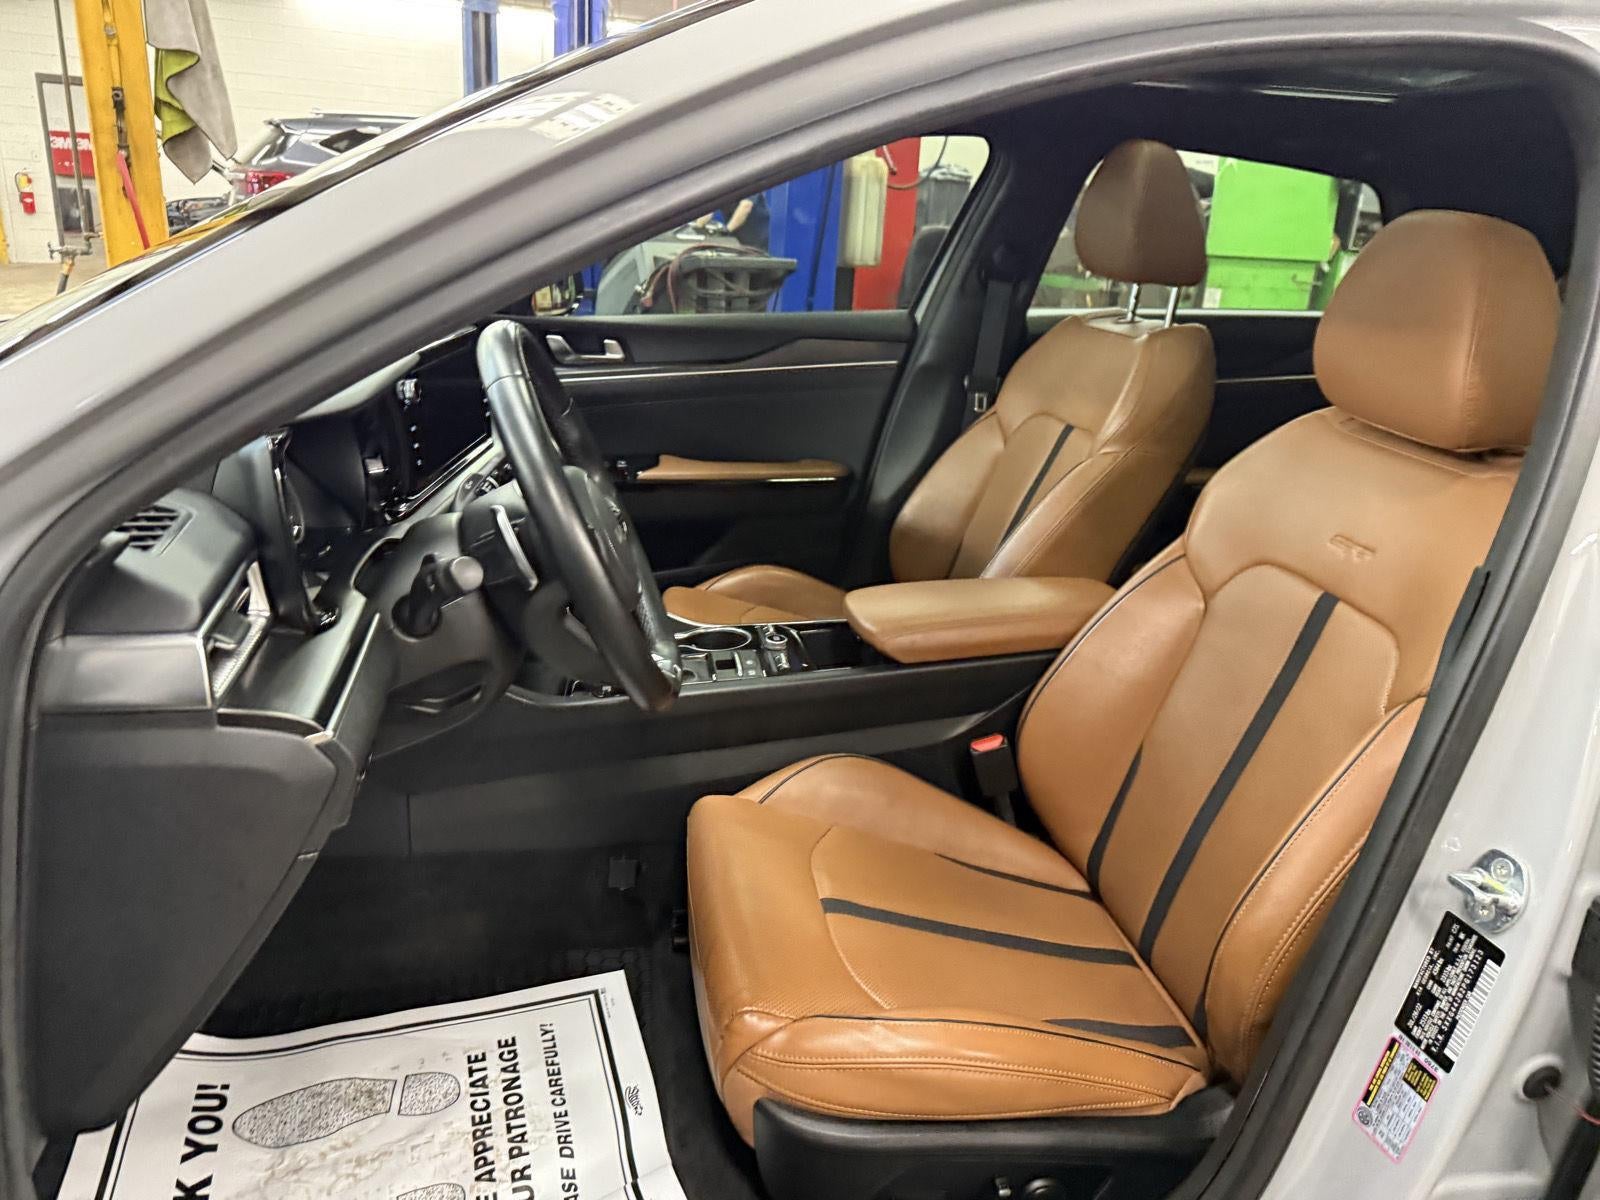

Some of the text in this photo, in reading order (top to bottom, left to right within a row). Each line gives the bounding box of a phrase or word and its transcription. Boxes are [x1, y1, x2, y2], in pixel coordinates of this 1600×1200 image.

[498, 1036, 530, 1160] PATRONAGE
[540, 1023, 567, 1107] CAREFULLY!
[180, 1084, 230, 1165] YOU!
[467, 1052, 497, 1183] APPRECIATE
[553, 1110, 575, 1159] DRIVE
